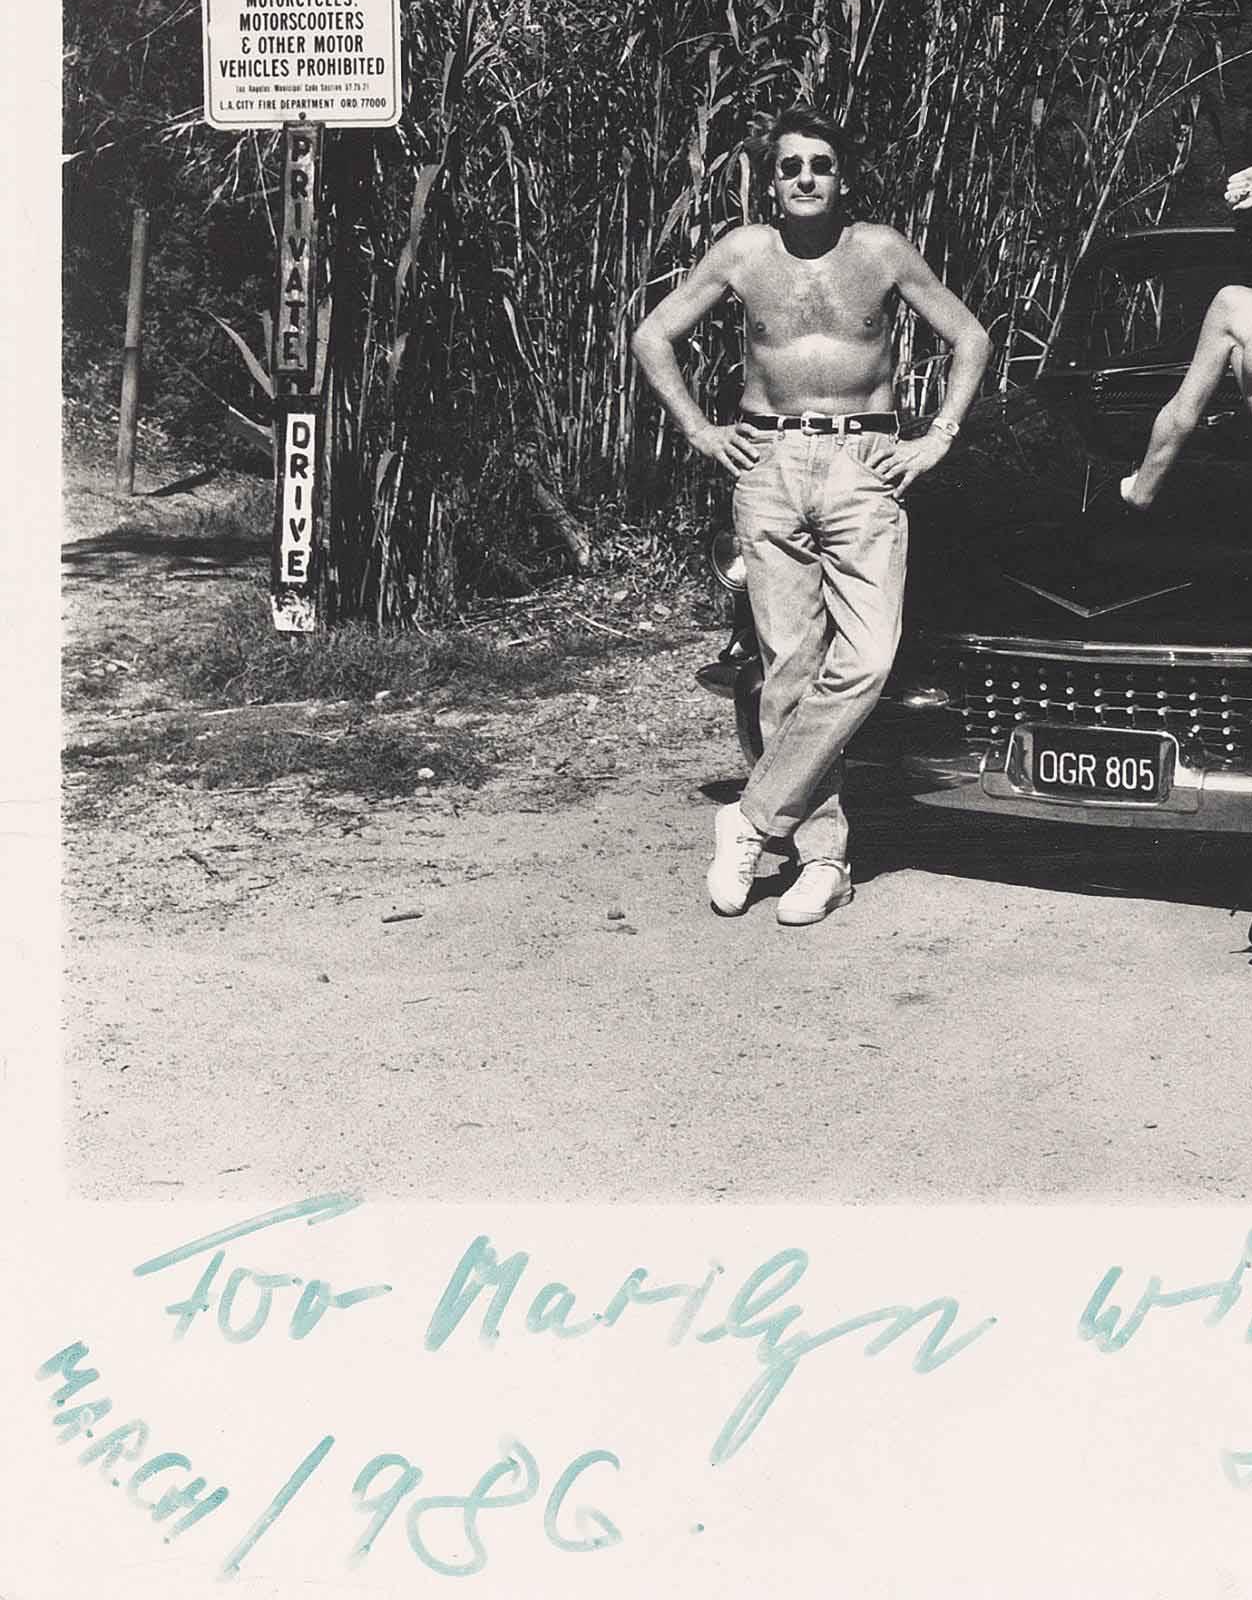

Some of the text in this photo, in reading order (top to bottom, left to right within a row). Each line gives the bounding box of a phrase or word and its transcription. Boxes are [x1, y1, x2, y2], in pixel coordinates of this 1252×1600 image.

[239, 11, 364, 32] MOTORSCOOTERS
[241, 34, 364, 55] & OTHER MOTOR
[219, 57, 385, 78] VEHICLES PROHIBITED
[258, 99, 276, 110] FIRE
[280, 99, 335, 110] DEPARTMENT
[360, 97, 387, 109] 77000
[283, 135, 311, 363] PRIVATE
[287, 421, 311, 577] DRIVE
[1039, 750, 1154, 791] OGR 805
[425, 1234, 1000, 1466] Marilyn
[36, 1340, 230, 1542] MARCH
